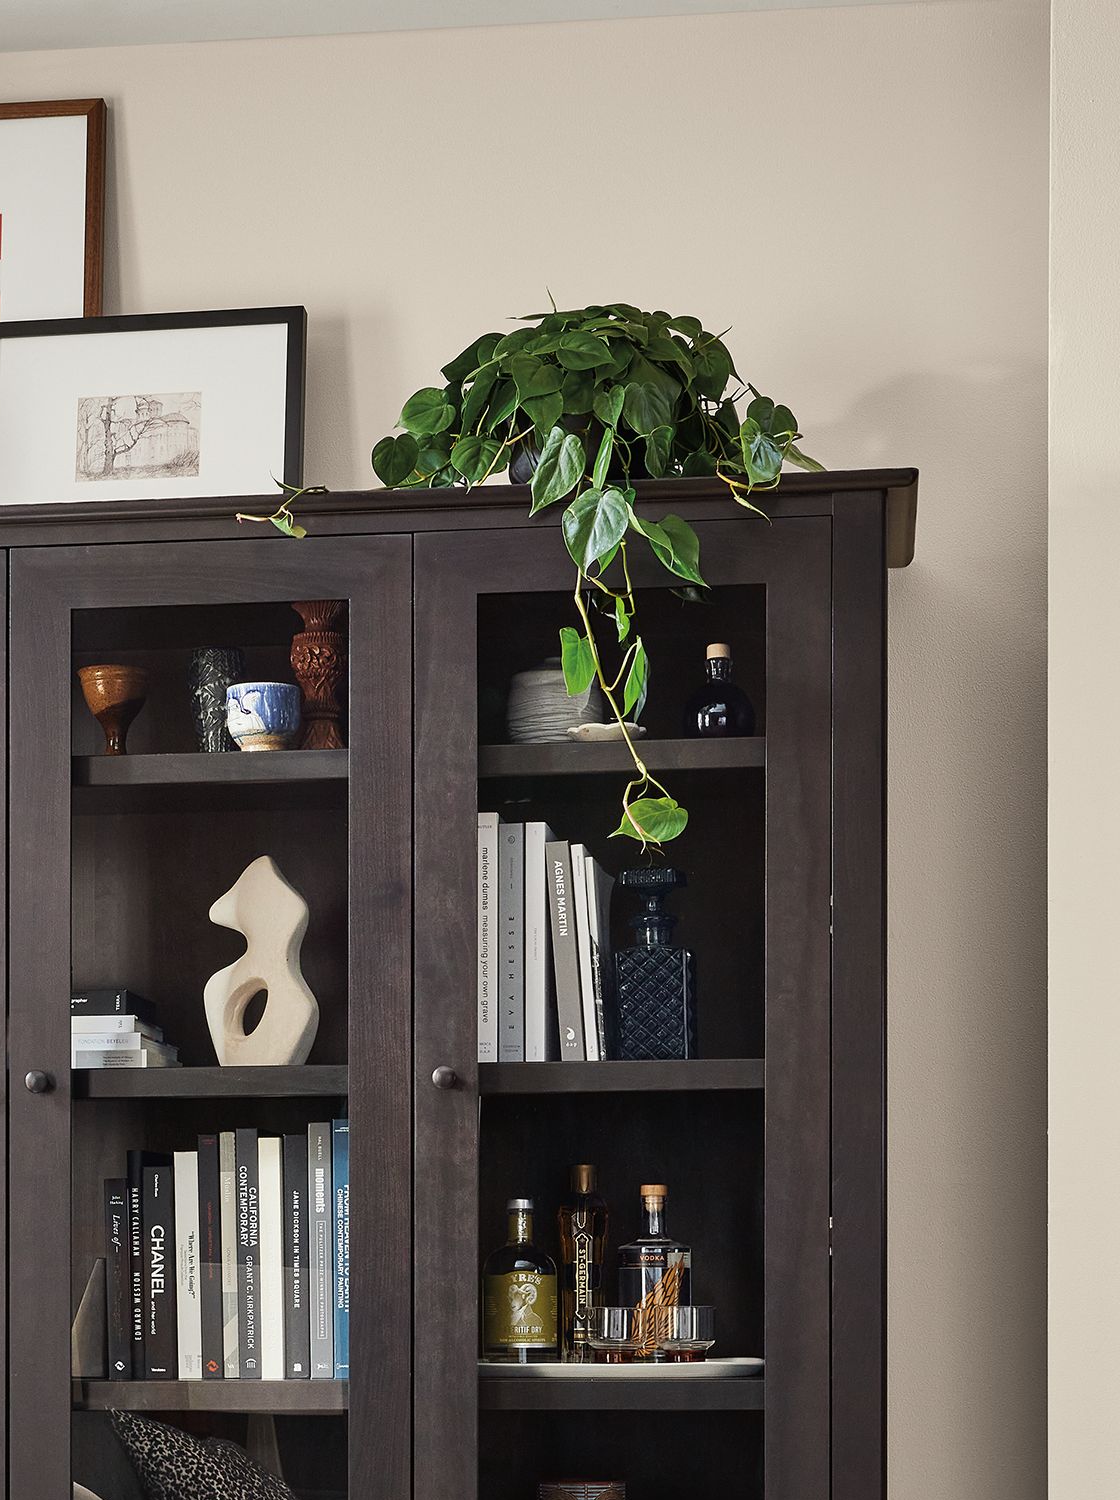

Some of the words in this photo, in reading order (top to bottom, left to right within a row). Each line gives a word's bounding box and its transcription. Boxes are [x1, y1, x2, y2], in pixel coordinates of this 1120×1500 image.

[482, 847, 490, 881] marlene
[554, 861, 566, 895] AGNES
[482, 882, 490, 910] dumas
[556, 897, 568, 936] MARTIN
[480, 915, 490, 958] measuring
[481, 960, 489, 978] your
[481, 1000, 489, 1023] grave
[131, 1187, 139, 1213] HARRY
[223, 1176, 232, 1203] Muslin
[292, 1191, 300, 1210] JANE
[314, 1168, 326, 1213] moments
[238, 1166, 249, 1247] CONTEMPORARY
[248, 1187, 258, 1247] CALIFORNIA
[112, 1214, 121, 1235] Lives
[132, 1216, 140, 1257] CALLAHAN
[150, 1225, 165, 1299] CHANEL
[293, 1245, 300, 1254] IN
[188, 1266, 195, 1275] We
[245, 1255, 254, 1283] GRANT
[510, 1273, 543, 1285] YRE'S
[133, 1272, 141, 1304] WESTON
[246, 1285, 254, 1294] C.
[293, 1279, 301, 1308] SQUARE
[134, 1307, 142, 1341] EDWARD
[246, 1295, 256, 1349] KIRKPATRICK
